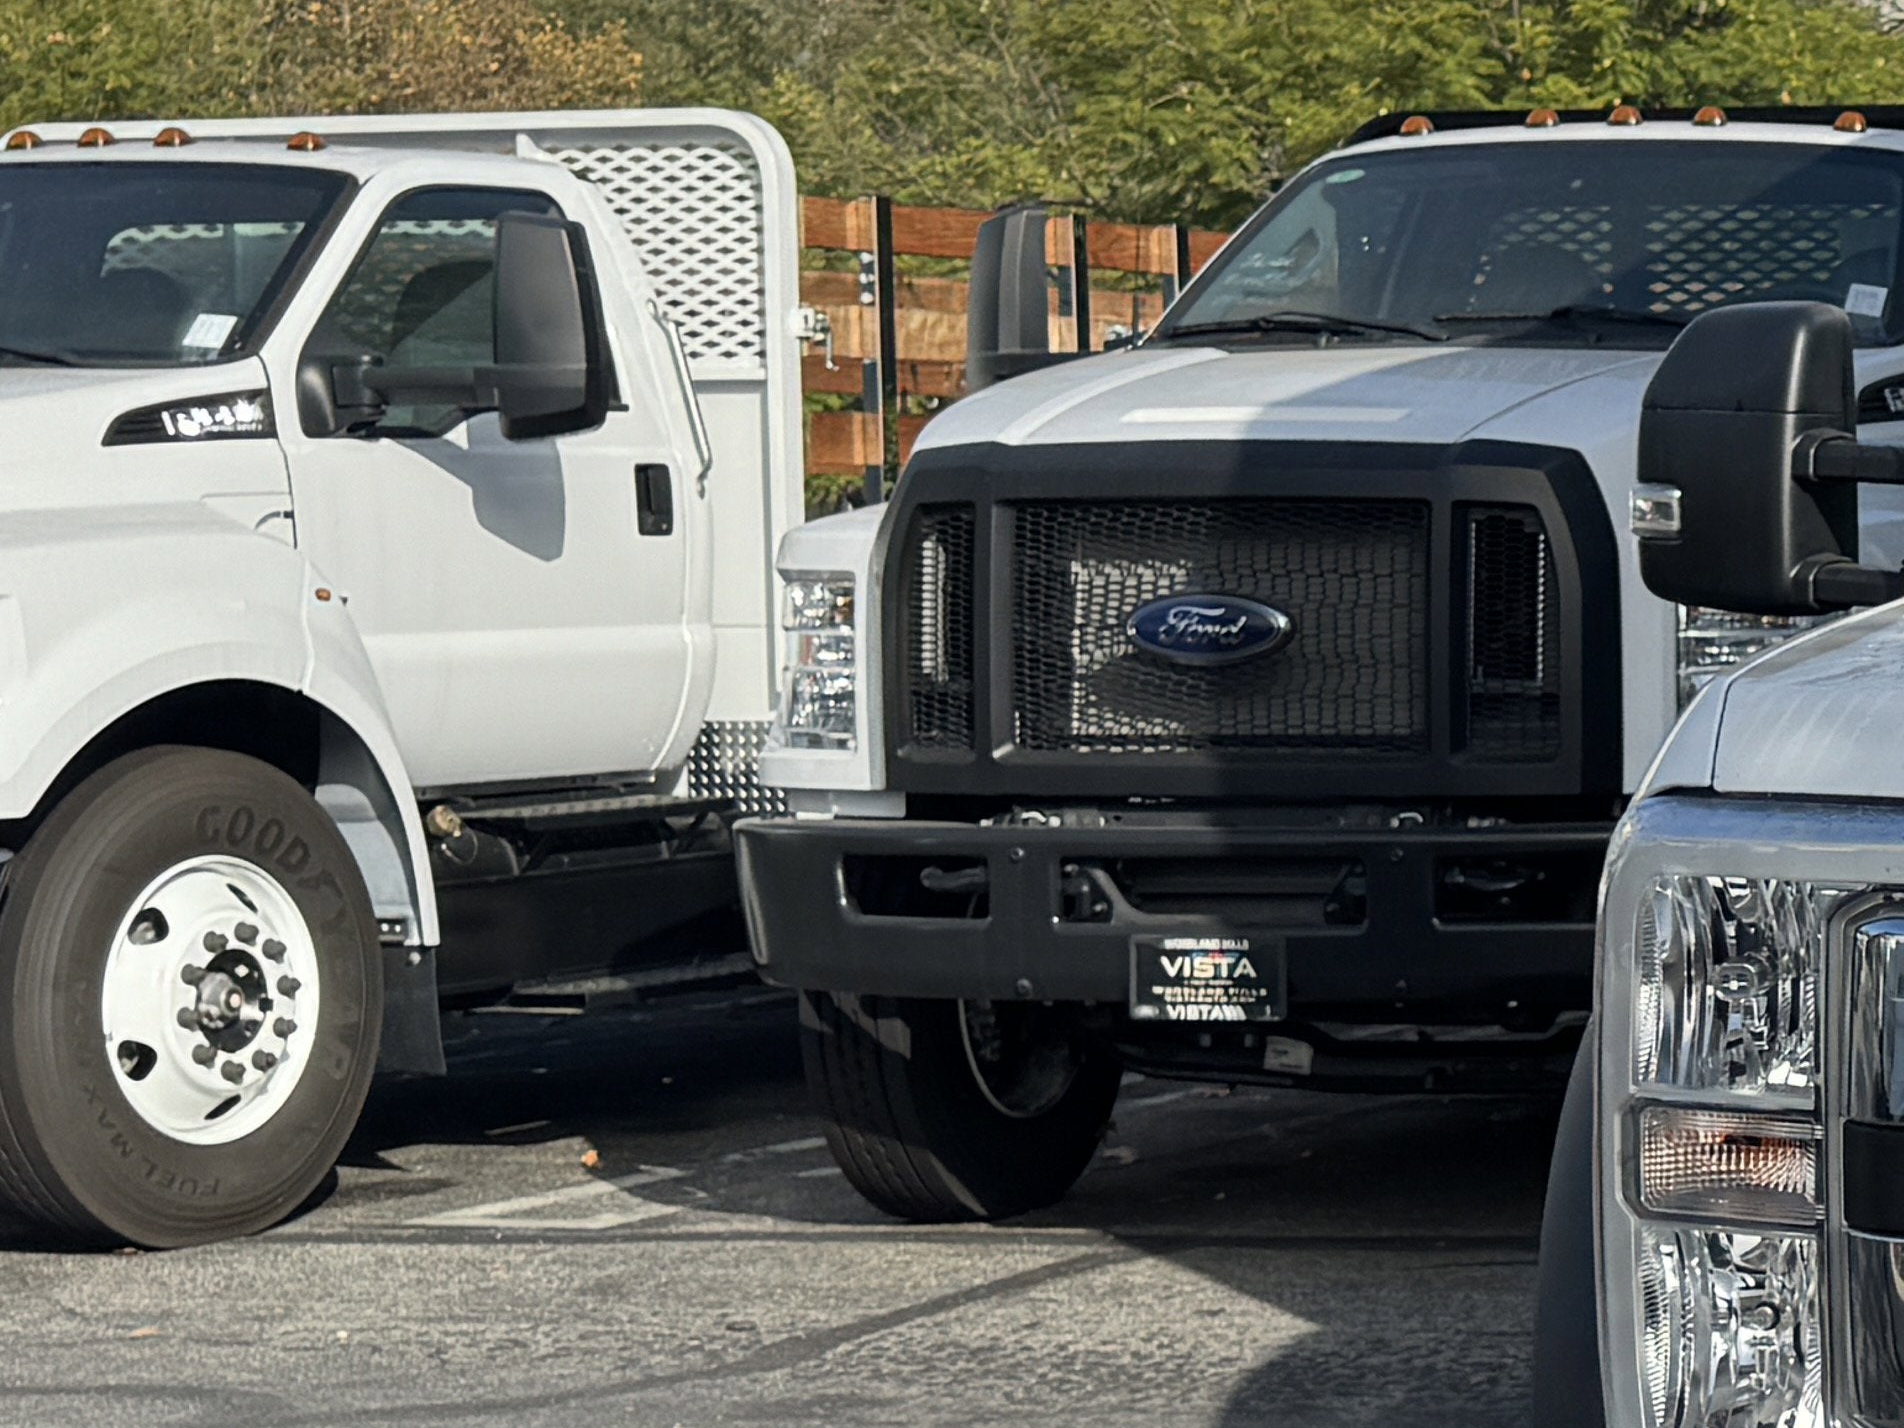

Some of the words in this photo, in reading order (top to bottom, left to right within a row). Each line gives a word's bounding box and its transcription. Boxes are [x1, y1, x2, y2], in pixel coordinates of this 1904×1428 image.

[1158, 605, 1248, 645] Ford
[1160, 955, 1258, 978] VISTA
[143, 1157, 221, 1197] FUEL
